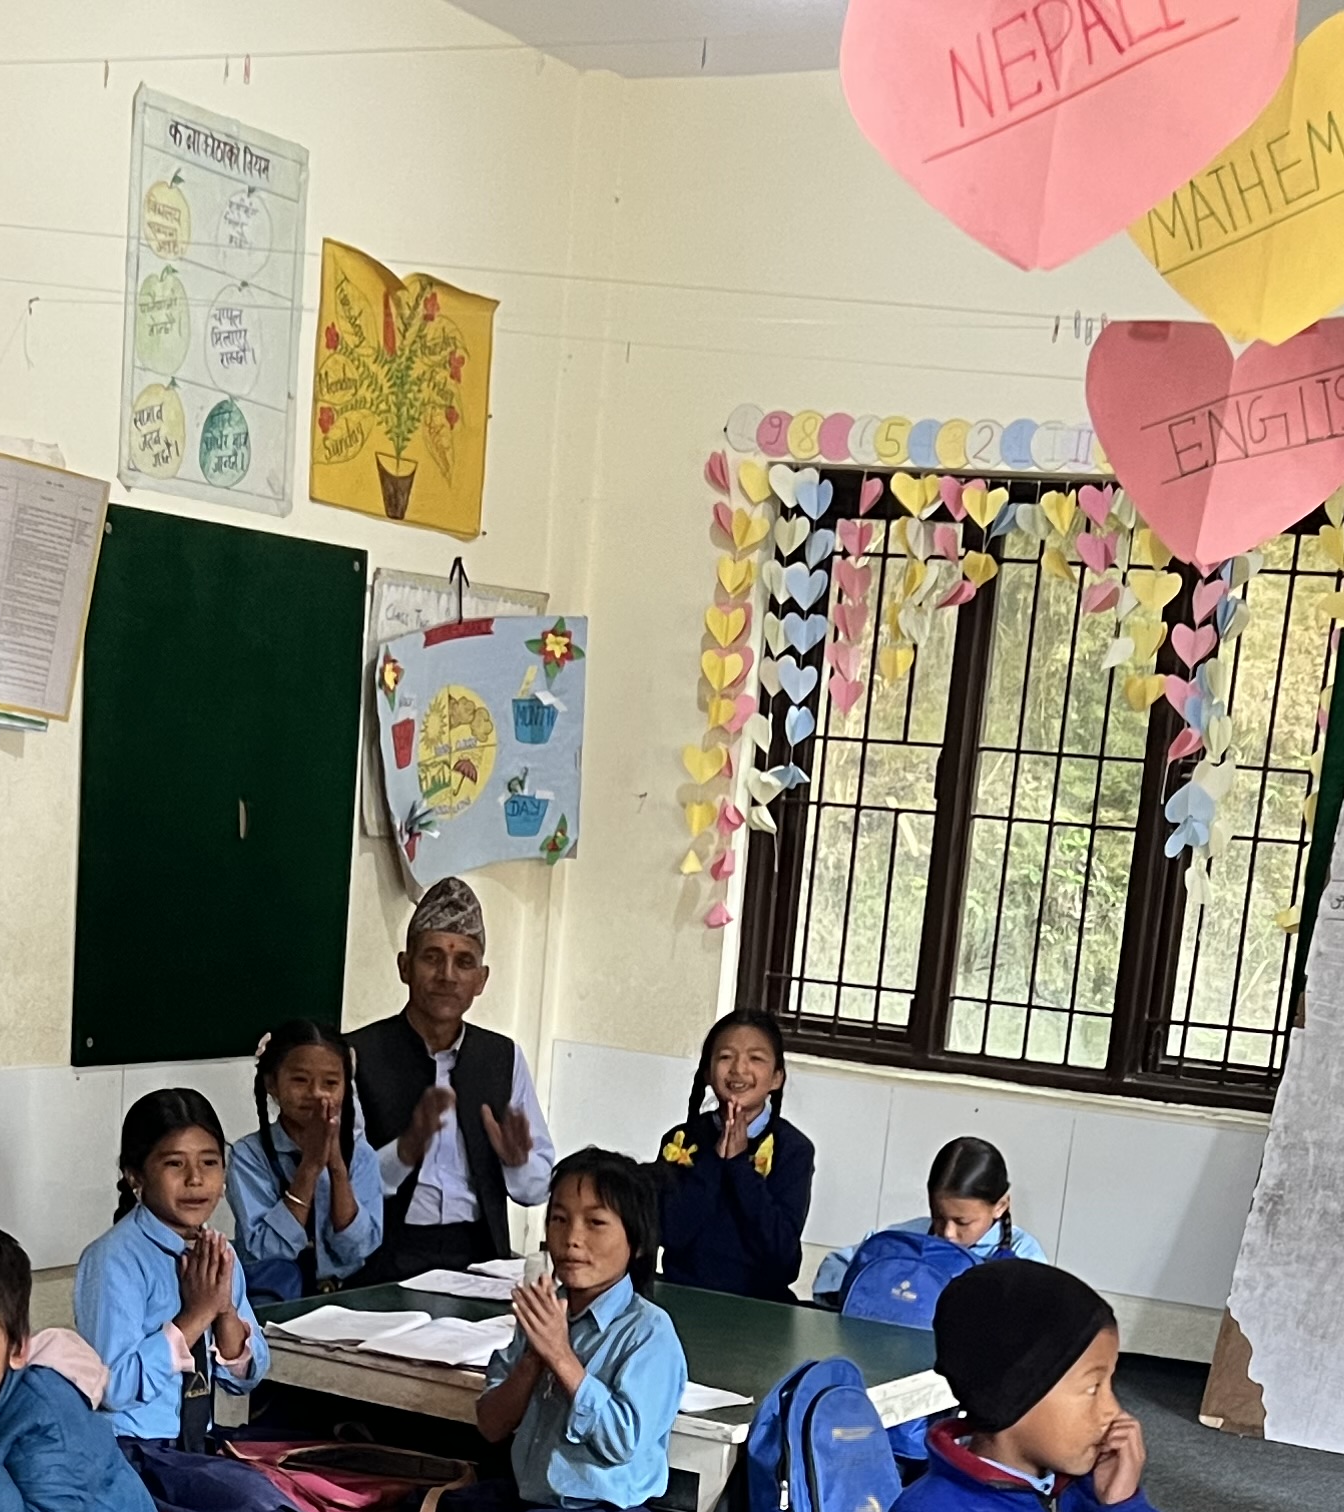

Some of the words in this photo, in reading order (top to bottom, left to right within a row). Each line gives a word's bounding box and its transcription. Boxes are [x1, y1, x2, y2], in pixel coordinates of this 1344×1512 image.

[317, 361, 359, 397] Monday
[322, 415, 365, 461] Sunday
[768, 416, 784, 446] 9
[797, 416, 816, 452] 8
[881, 423, 905, 458] 5
[973, 422, 996, 462] 2
[514, 702, 558, 731] MONTH
[507, 799, 542, 818] DAY
